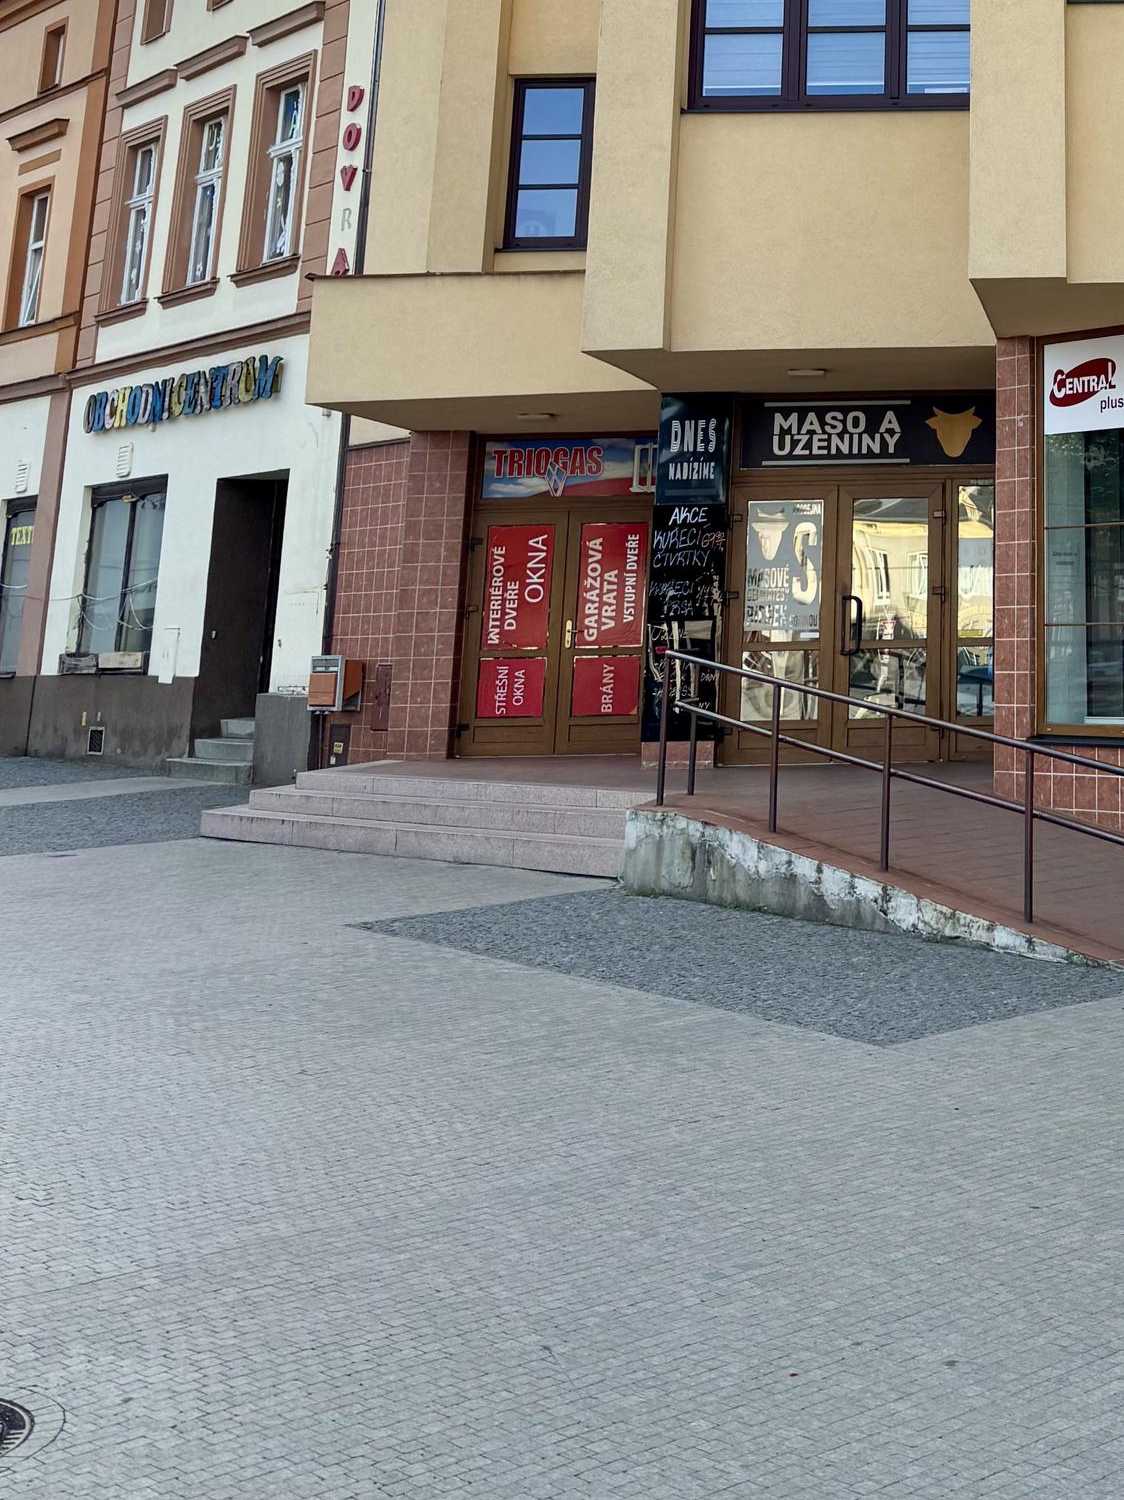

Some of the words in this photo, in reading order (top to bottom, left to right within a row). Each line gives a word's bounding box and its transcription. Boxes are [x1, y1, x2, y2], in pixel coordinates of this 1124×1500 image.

[172, 354, 284, 417] CENTRUM
[1053, 360, 1117, 399] CENTRAL
[773, 411, 866, 435] MASO
[879, 410, 901, 433] A
[1100, 395, 1124, 413] plus
[670, 418, 717, 453] DNES
[773, 432, 901, 456] UZENINY
[493, 446, 604, 479] TRIOGAS
[669, 506, 709, 526] AKCE
[625, 534, 640, 570] DVEŘE
[653, 523, 711, 549] KUŘECÍ
[524, 534, 548, 603] OKNA
[653, 549, 711, 568] ČTVRTKY
[487, 546, 506, 645] INTERIÉROVÉ
[504, 580, 520, 631] DVEŘE
[583, 537, 604, 642] GARÁŽOVÁ
[601, 569, 619, 630] VRATA
[623, 572, 638, 622] VSTUPNÍ
[496, 666, 510, 715] STŘEŠNÍ
[512, 669, 525, 706] OKNA
[600, 664, 616, 713] BRÁNY
